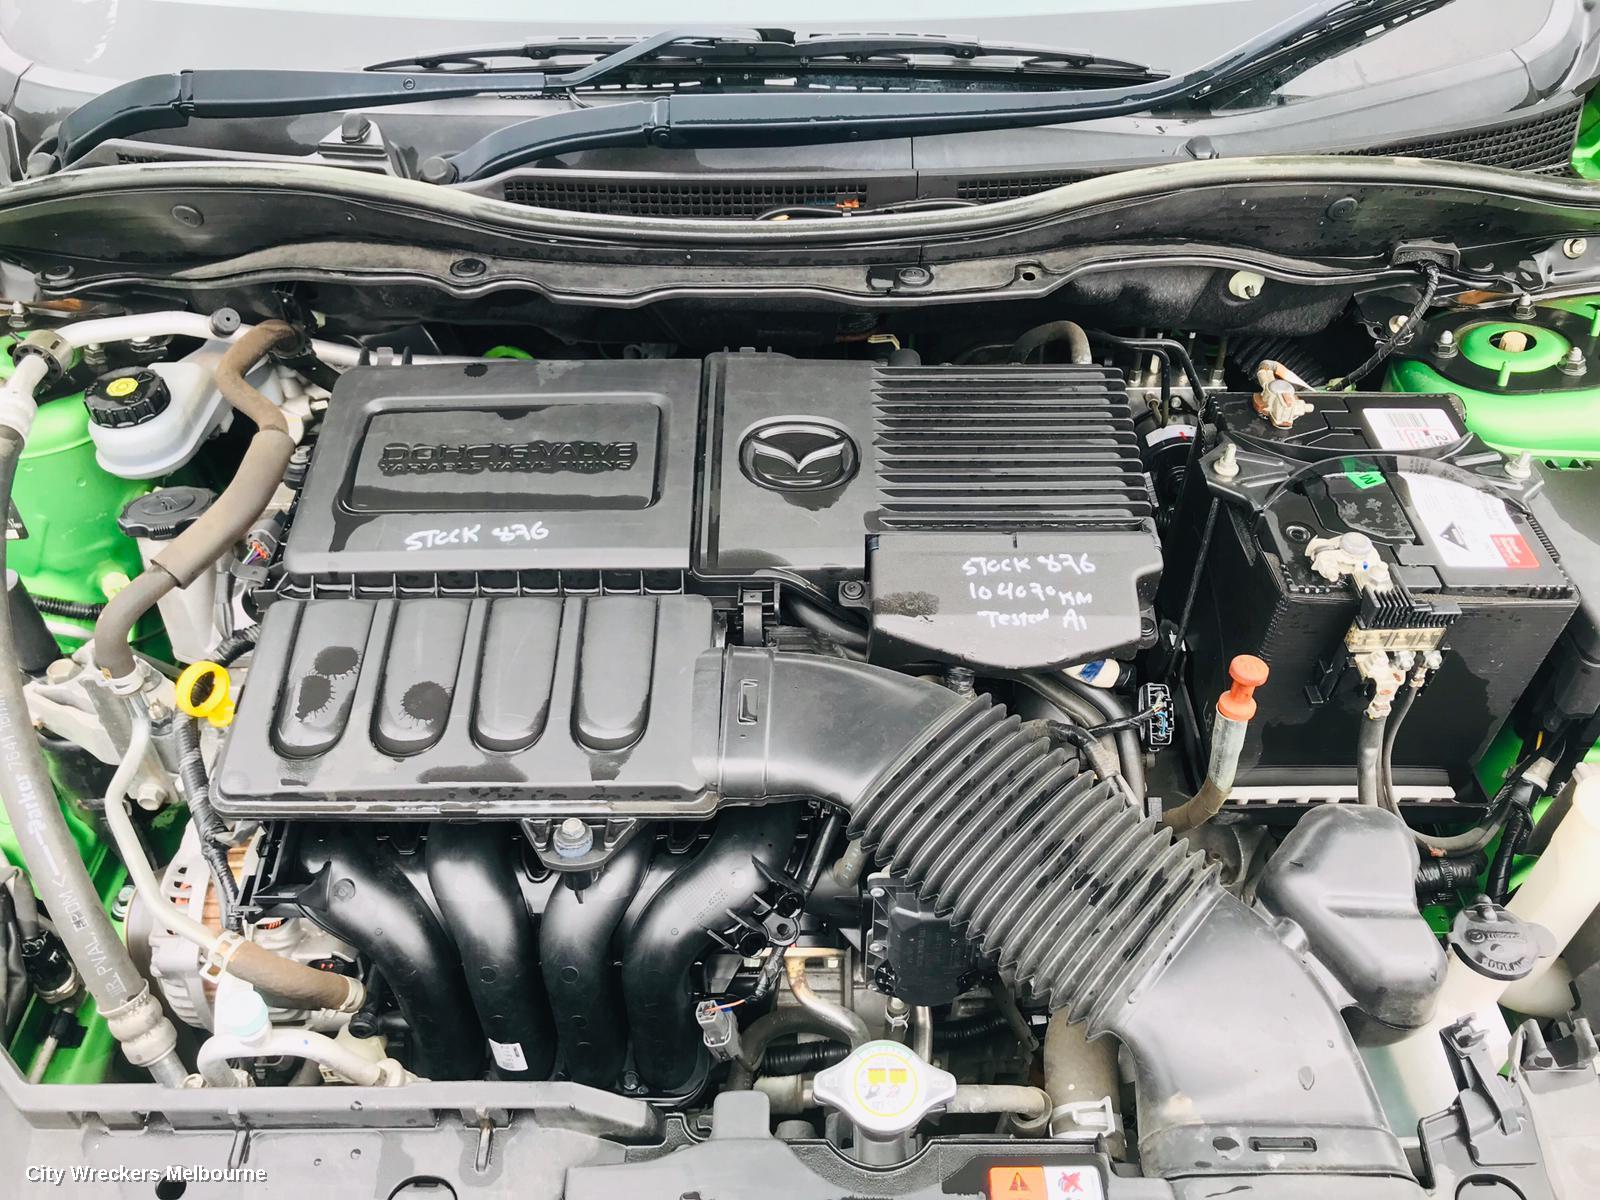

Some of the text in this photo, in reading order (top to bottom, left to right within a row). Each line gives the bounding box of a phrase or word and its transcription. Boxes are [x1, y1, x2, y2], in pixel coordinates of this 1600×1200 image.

[382, 443, 495, 460] DOHC
[404, 523, 482, 551] STOCK
[962, 552, 1097, 576] STOCK 876
